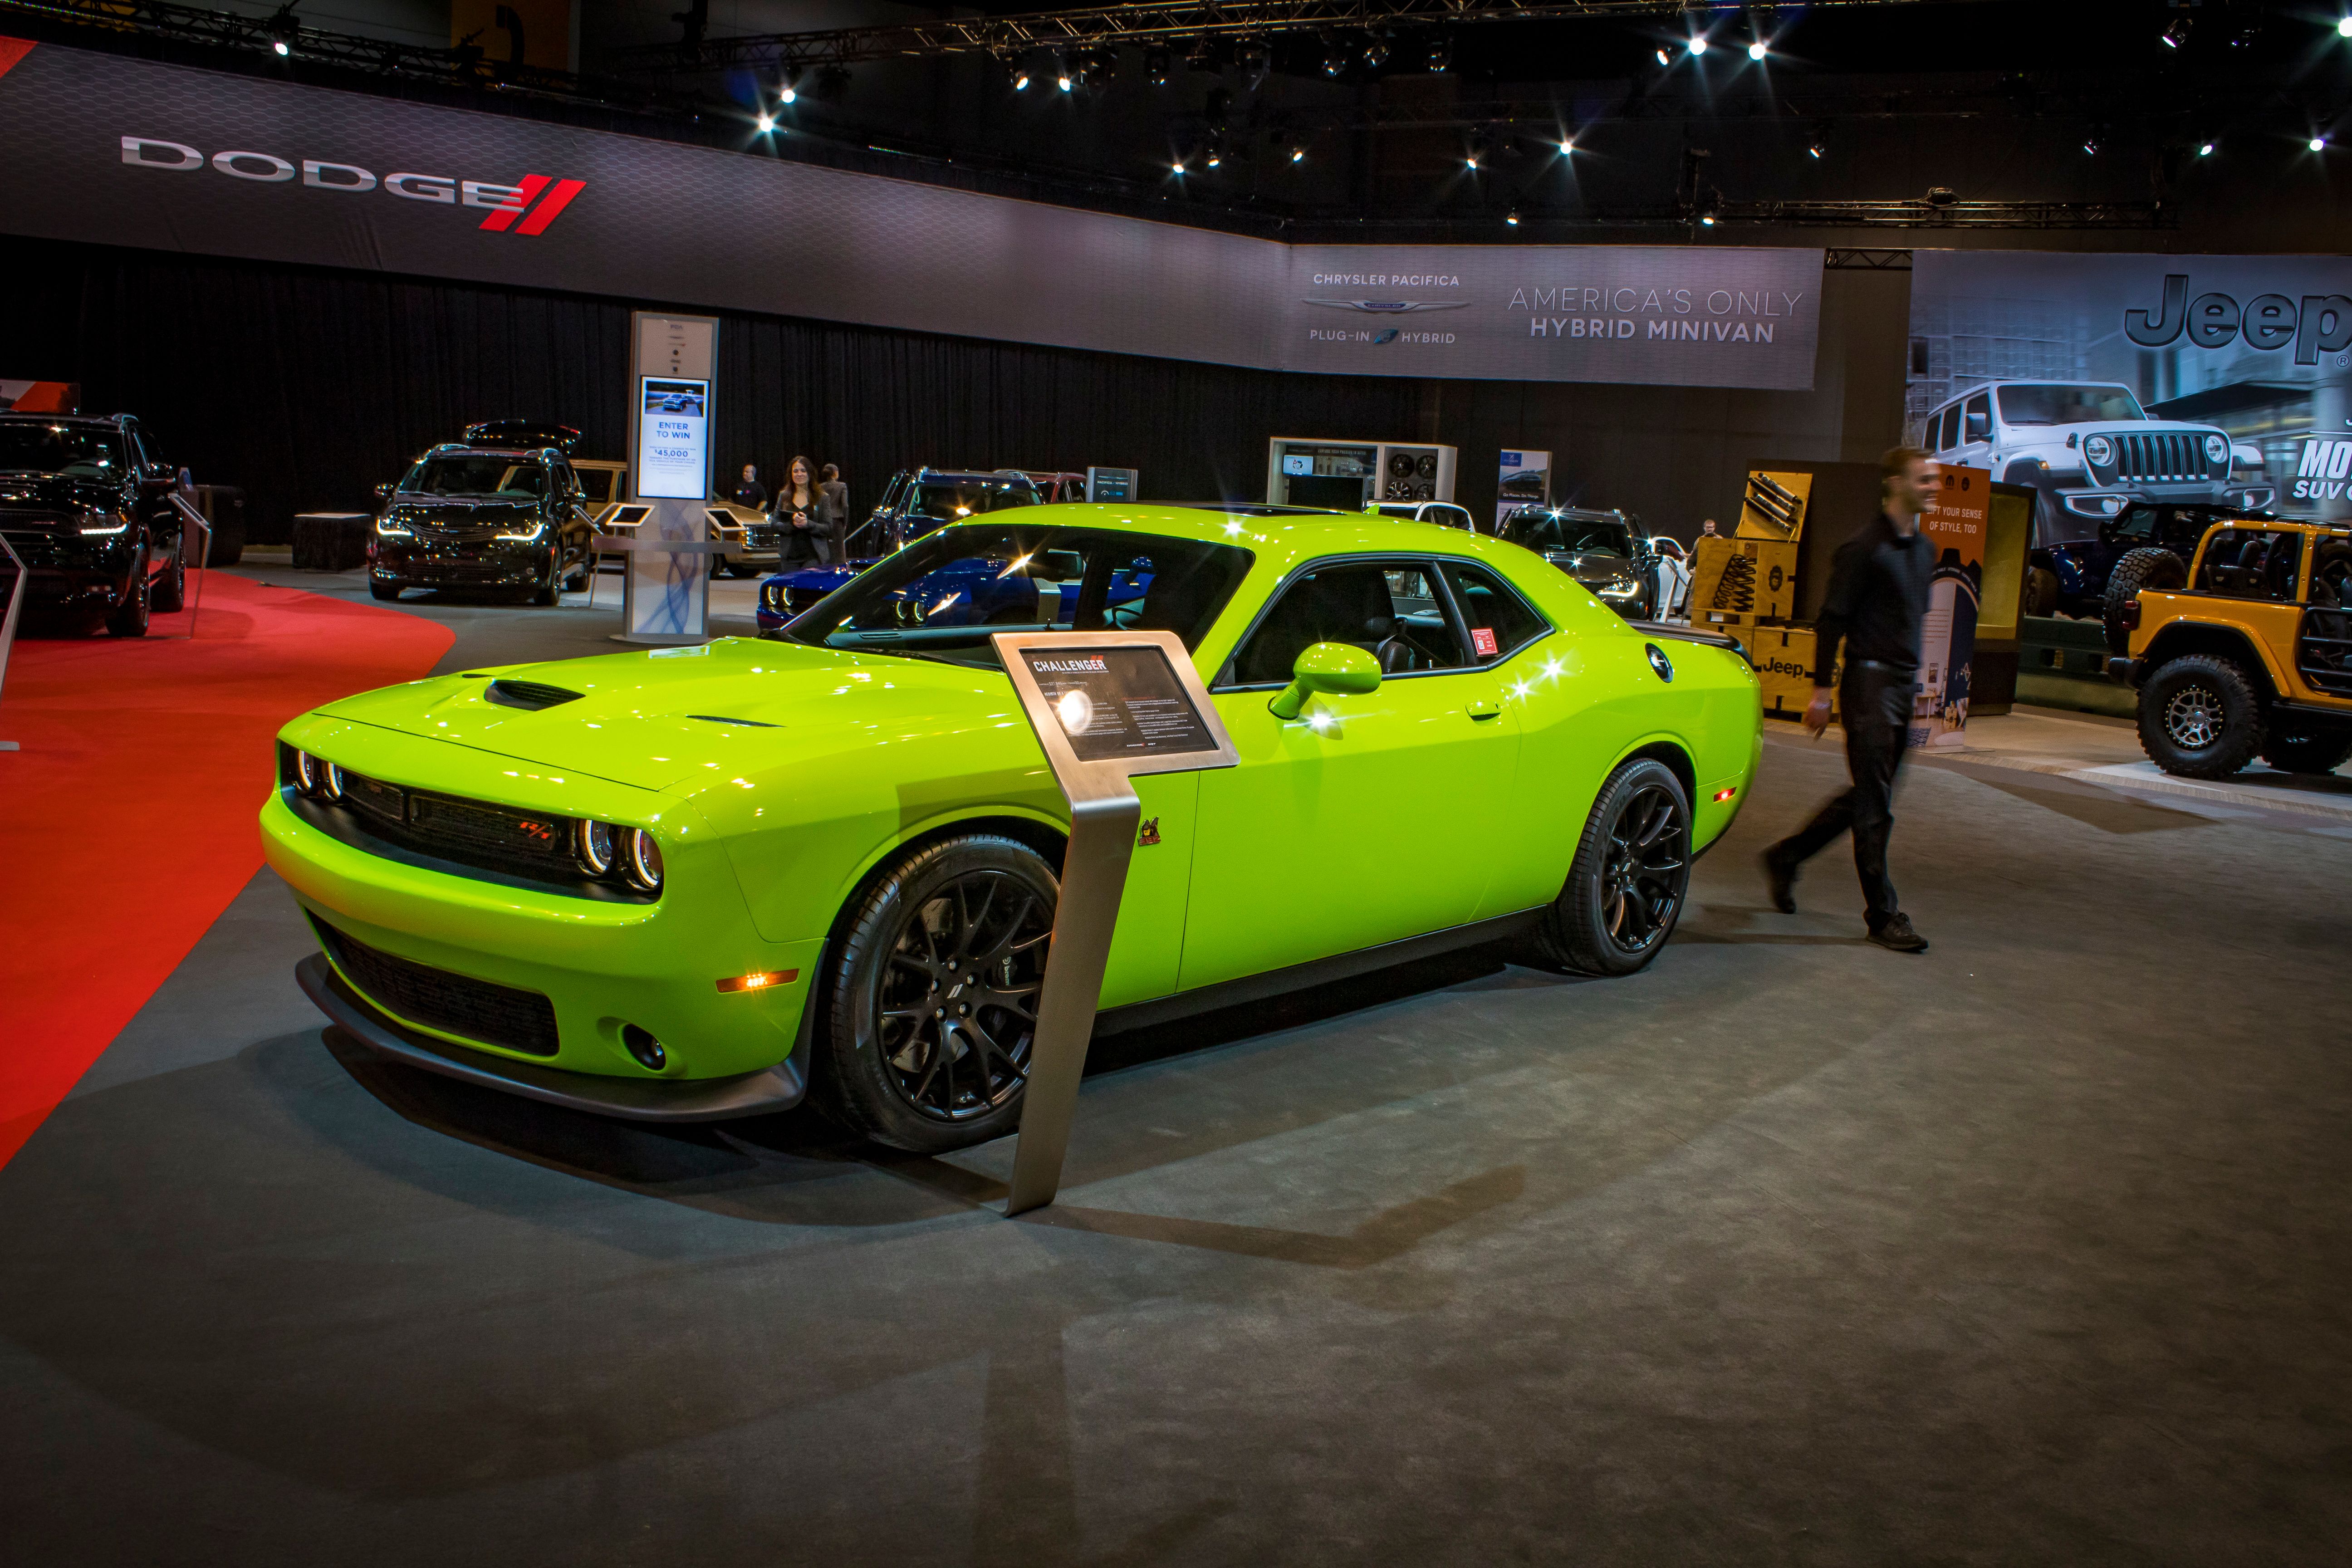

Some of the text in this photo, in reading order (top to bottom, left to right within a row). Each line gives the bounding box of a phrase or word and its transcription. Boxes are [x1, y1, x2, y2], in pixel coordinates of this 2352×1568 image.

[122, 136, 524, 213] DODGE
[1313, 274, 1460, 286] CHRYSLER PACIFICA
[1508, 287, 1803, 317] AMERICA'S ONLY
[2125, 274, 2352, 365] Jeep
[1310, 329, 1455, 343] PLUG-IN HYBRID
[1530, 318, 1774, 343] HYBRID MINIVAN
[2293, 480, 2344, 500] SUV
[1943, 507, 1960, 516] YOUR
[1962, 509, 1982, 519] SENSE
[1930, 521, 1976, 534] OF STYLE, TOO
[1033, 660, 1107, 671] CHALLENGER
[1763, 657, 1803, 678] Jeep
